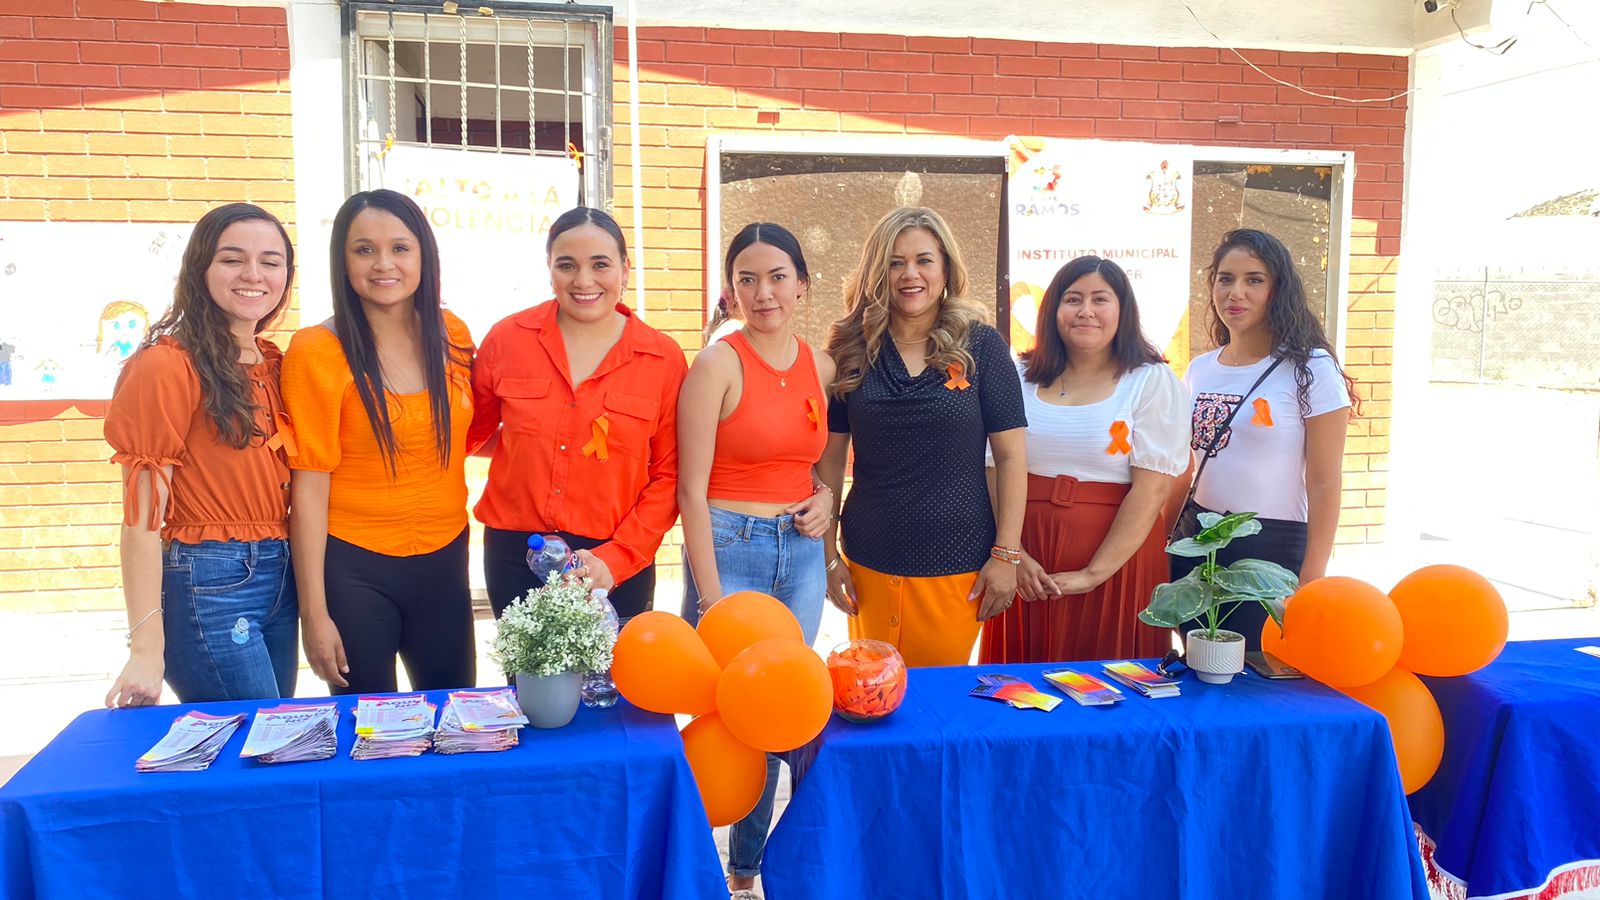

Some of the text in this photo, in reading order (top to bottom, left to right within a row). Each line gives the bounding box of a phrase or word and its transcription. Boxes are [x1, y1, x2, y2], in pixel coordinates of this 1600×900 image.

[1015, 203, 1081, 217] RAMOS
[1017, 247, 1179, 261] INSTITUTO MUNICIPAL
